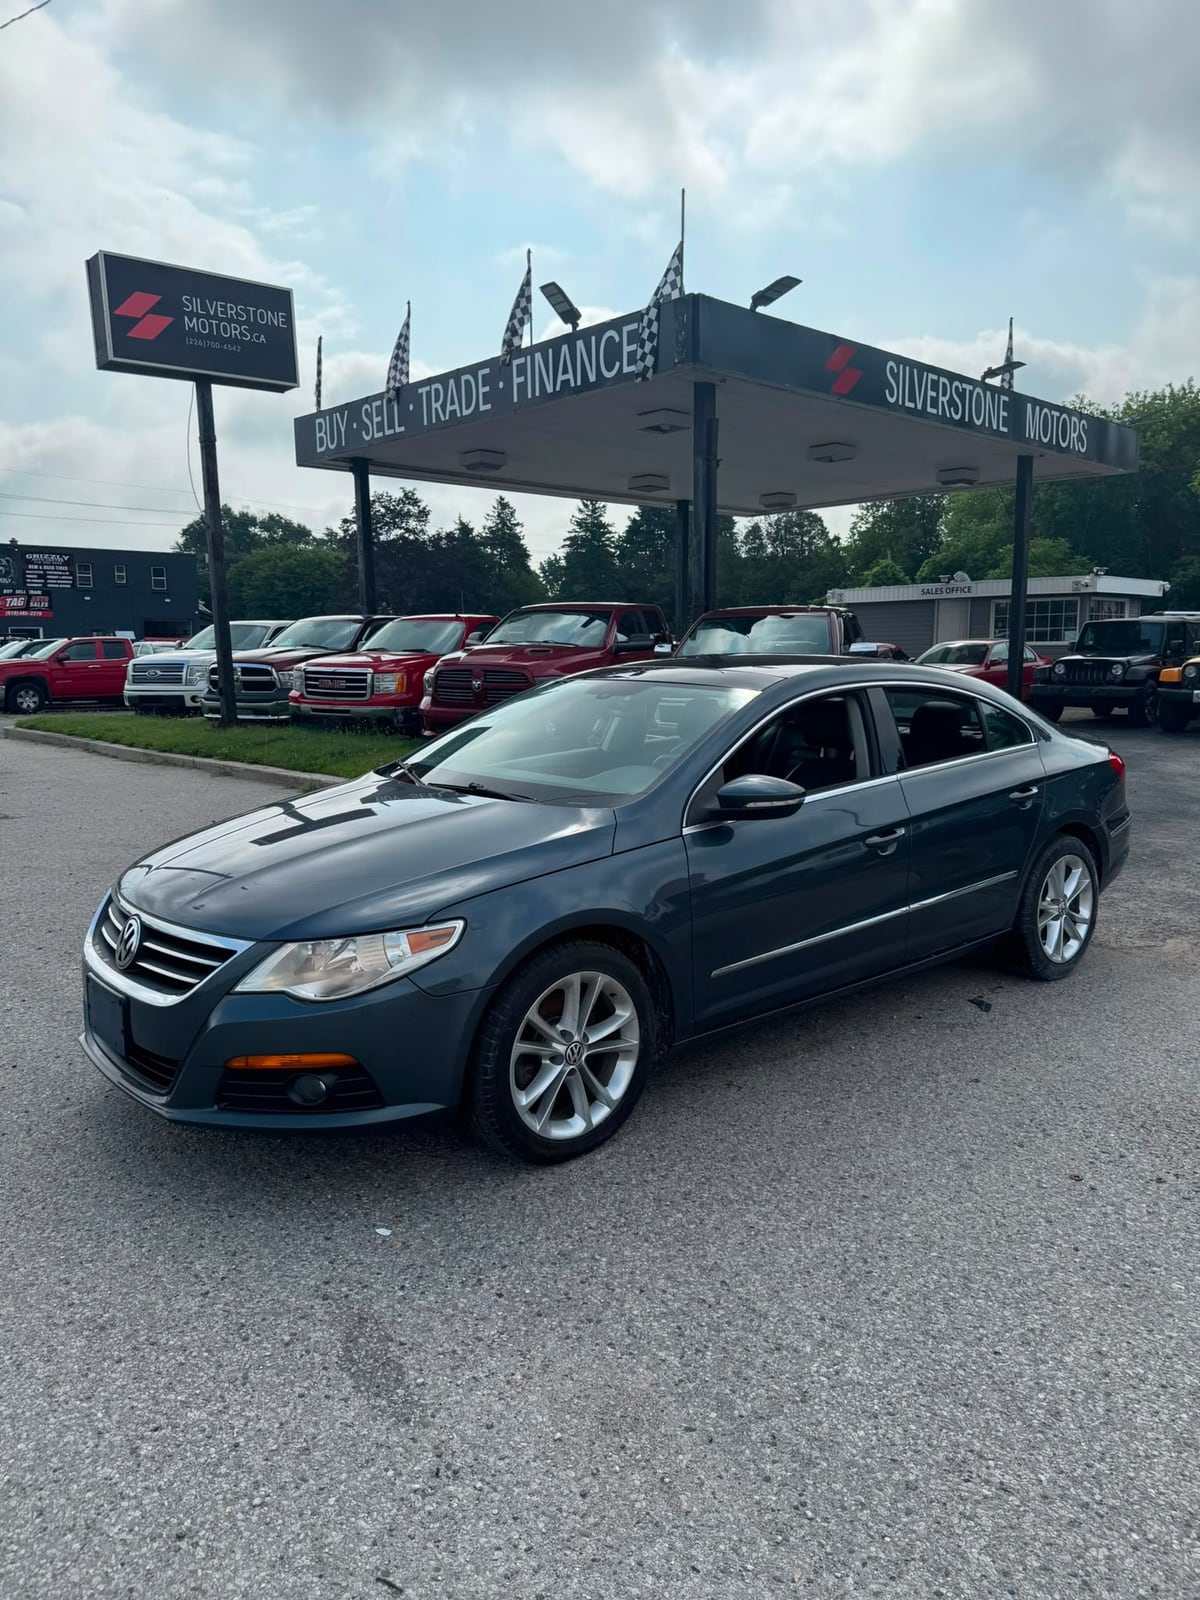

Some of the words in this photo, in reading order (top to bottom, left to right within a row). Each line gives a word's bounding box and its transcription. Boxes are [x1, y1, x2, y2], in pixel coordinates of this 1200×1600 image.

[182, 295, 288, 328] SILVERSTONE
[184, 315, 266, 344] MOTORS.CA
[315, 409, 348, 453] BUY
[362, 398, 405, 441] SELL
[418, 367, 492, 426] TRADE
[512, 322, 638, 403] FINANCE
[885, 360, 1009, 433] SILVERSTONE
[1025, 402, 1088, 453] MOTORS
[25, 553, 70, 561] GRIZZLY
[921, 587, 943, 596] SALES
[945, 585, 972, 594] OFFICE
[5, 597, 25, 607] TAG
[318, 679, 346, 689] GMC
